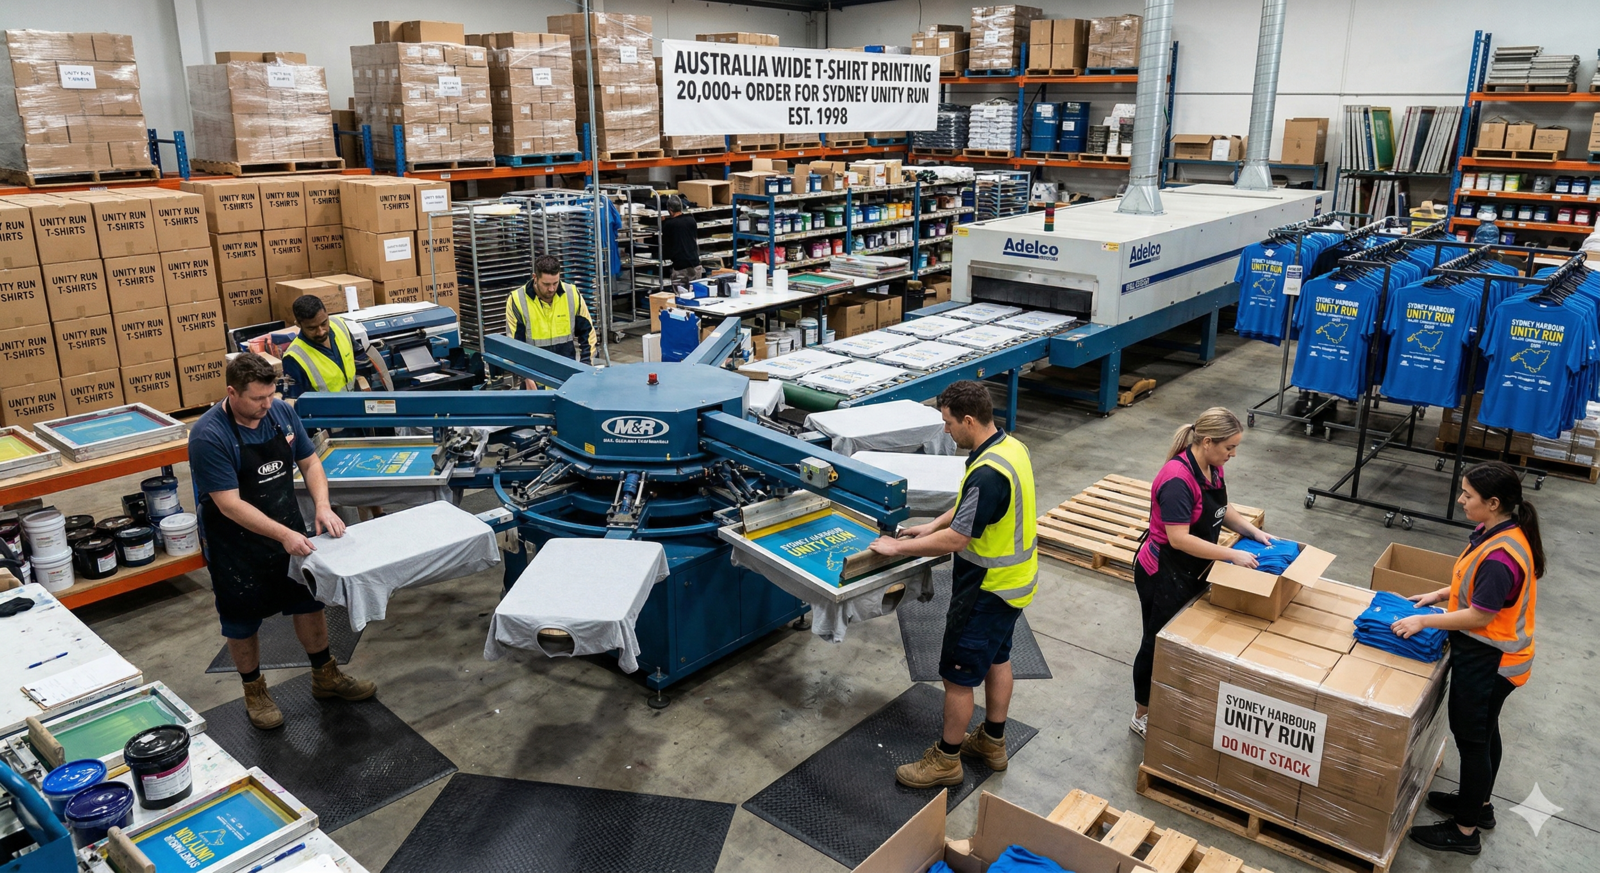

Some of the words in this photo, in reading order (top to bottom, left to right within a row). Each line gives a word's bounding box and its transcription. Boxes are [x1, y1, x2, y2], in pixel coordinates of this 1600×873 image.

[674, 50, 768, 77] AUSTRALIA
[772, 56, 812, 79] WIDE
[816, 59, 868, 80] T-SHIRT
[872, 62, 931, 83] PRINTING
[676, 80, 741, 102] 20,000+
[746, 82, 791, 102] ORDER
[795, 84, 819, 102] FOR
[823, 85, 868, 102] SYDNEY
[871, 87, 904, 103] UNITY
[907, 87, 929, 103] RUN
[788, 107, 813, 125] EST.
[817, 107, 848, 125] 1998
[158, 208, 182, 217] UNITY
[184, 207, 200, 215] RUN
[223, 202, 253, 211] T-SHIRTS
[383, 202, 409, 210] T-SHIRTS
[40, 217, 66, 227] UNITY
[69, 215, 87, 224] RUN
[102, 212, 127, 222] UNITY
[129, 211, 146, 220] RUN
[163, 216, 199, 226] T-SHIRTS
[6, 221, 25, 230] RUN
[45, 226, 86, 237] T-SHIRTS
[107, 221, 144, 231] T-SHIRTS
[272, 246, 300, 254] T-SHIRTS
[425, 245, 449, 253] T-HIRTS
[1004, 238, 1059, 256] Adelco
[1130, 242, 1161, 262] Adelco
[226, 250, 256, 259] T-SHIRTS
[112, 268, 137, 277] UNITY
[139, 266, 156, 274] RUN
[168, 262, 191, 271] UNITY
[193, 260, 209, 268] RUN
[1251, 263, 1269, 271] UNITY
[52, 274, 78, 285] UNITY
[80, 272, 98, 281] RUN
[173, 269, 208, 280] T-SHIRTS
[0, 282, 14, 291] ITY
[17, 280, 36, 289] RUN
[117, 276, 154, 287] T-SHIRTS
[57, 283, 97, 294] T-SHIRTS
[229, 291, 248, 299] UNITY
[389, 289, 406, 297] UNITY
[1, 291, 34, 302] SHIRTS
[232, 297, 262, 307] T-SHIRTS
[1316, 303, 1339, 314] UNITY
[1340, 306, 1358, 317] RUN
[1407, 309, 1433, 320] UNITY
[1435, 312, 1454, 323] RUN
[177, 314, 199, 324] UNITY
[200, 311, 217, 320] RUN
[121, 322, 146, 332] UNITY
[148, 319, 164, 328] RUN
[182, 320, 216, 332] T-SHIRTS
[1511, 319, 1535, 327] SYDNEY
[1536, 322, 1565, 332] HARBOUR
[62, 330, 88, 341] UNITY
[90, 327, 108, 337] RUN
[126, 328, 162, 341] T-SHIRTS
[1511, 326, 1540, 339] UNITY
[1542, 330, 1564, 342] RUN
[0, 339, 25, 350] UNITY
[28, 336, 47, 346] RUN
[68, 337, 106, 350] T-SHIRTS
[4, 347, 45, 360] T-SHIRTS
[184, 364, 206, 374] UNITY
[207, 360, 223, 370] RUN
[129, 374, 153, 385] UNITY
[155, 371, 171, 380] RUN
[188, 370, 221, 382] T-SHIRTS
[70, 385, 96, 396] UNITY
[98, 381, 115, 391] RUN
[134, 381, 170, 394] T-SHIRTS
[8, 395, 36, 408] UNITY
[38, 392, 57, 402] RUN
[75, 391, 114, 405] T-SHIRTS
[14, 403, 55, 418] T-SHIRTS
[614, 420, 656, 435] M&R
[787, 539, 829, 557] UNITY
[1226, 694, 1265, 716] SYDNEY
[1268, 707, 1316, 733] HARBOUR
[1224, 707, 1274, 738] UNITY
[1278, 726, 1315, 753] RUN
[1222, 735, 1238, 752] DO
[1242, 742, 1266, 761] NOT
[1269, 752, 1311, 777] STACK
[186, 840, 215, 862] UNITY
